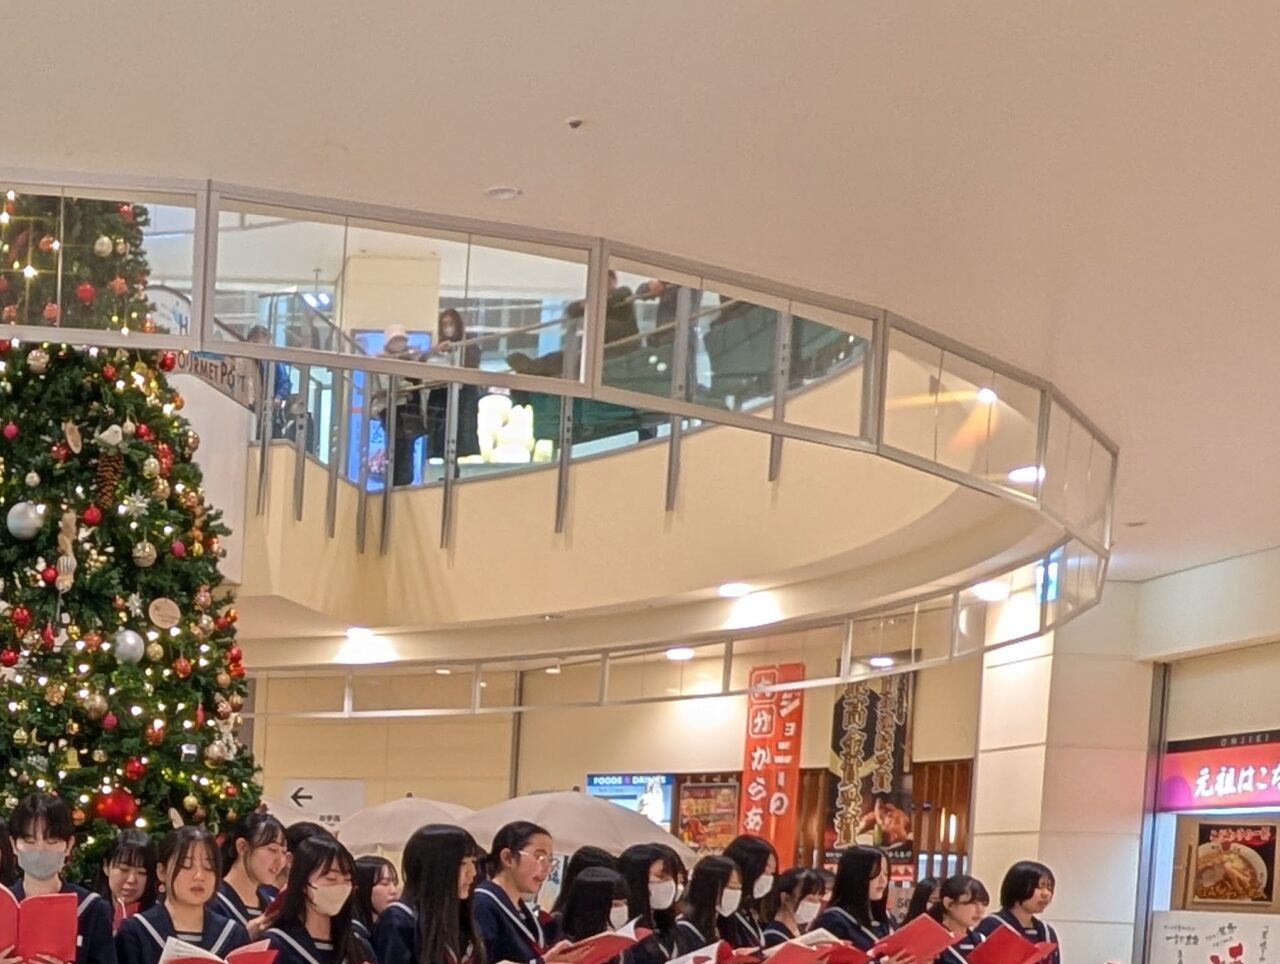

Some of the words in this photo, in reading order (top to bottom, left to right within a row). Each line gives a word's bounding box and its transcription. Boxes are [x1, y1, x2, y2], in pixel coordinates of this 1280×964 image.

[176, 350, 219, 382] OURMET
[220, 361, 246, 392] POT
[593, 776, 623, 785] FOODS
